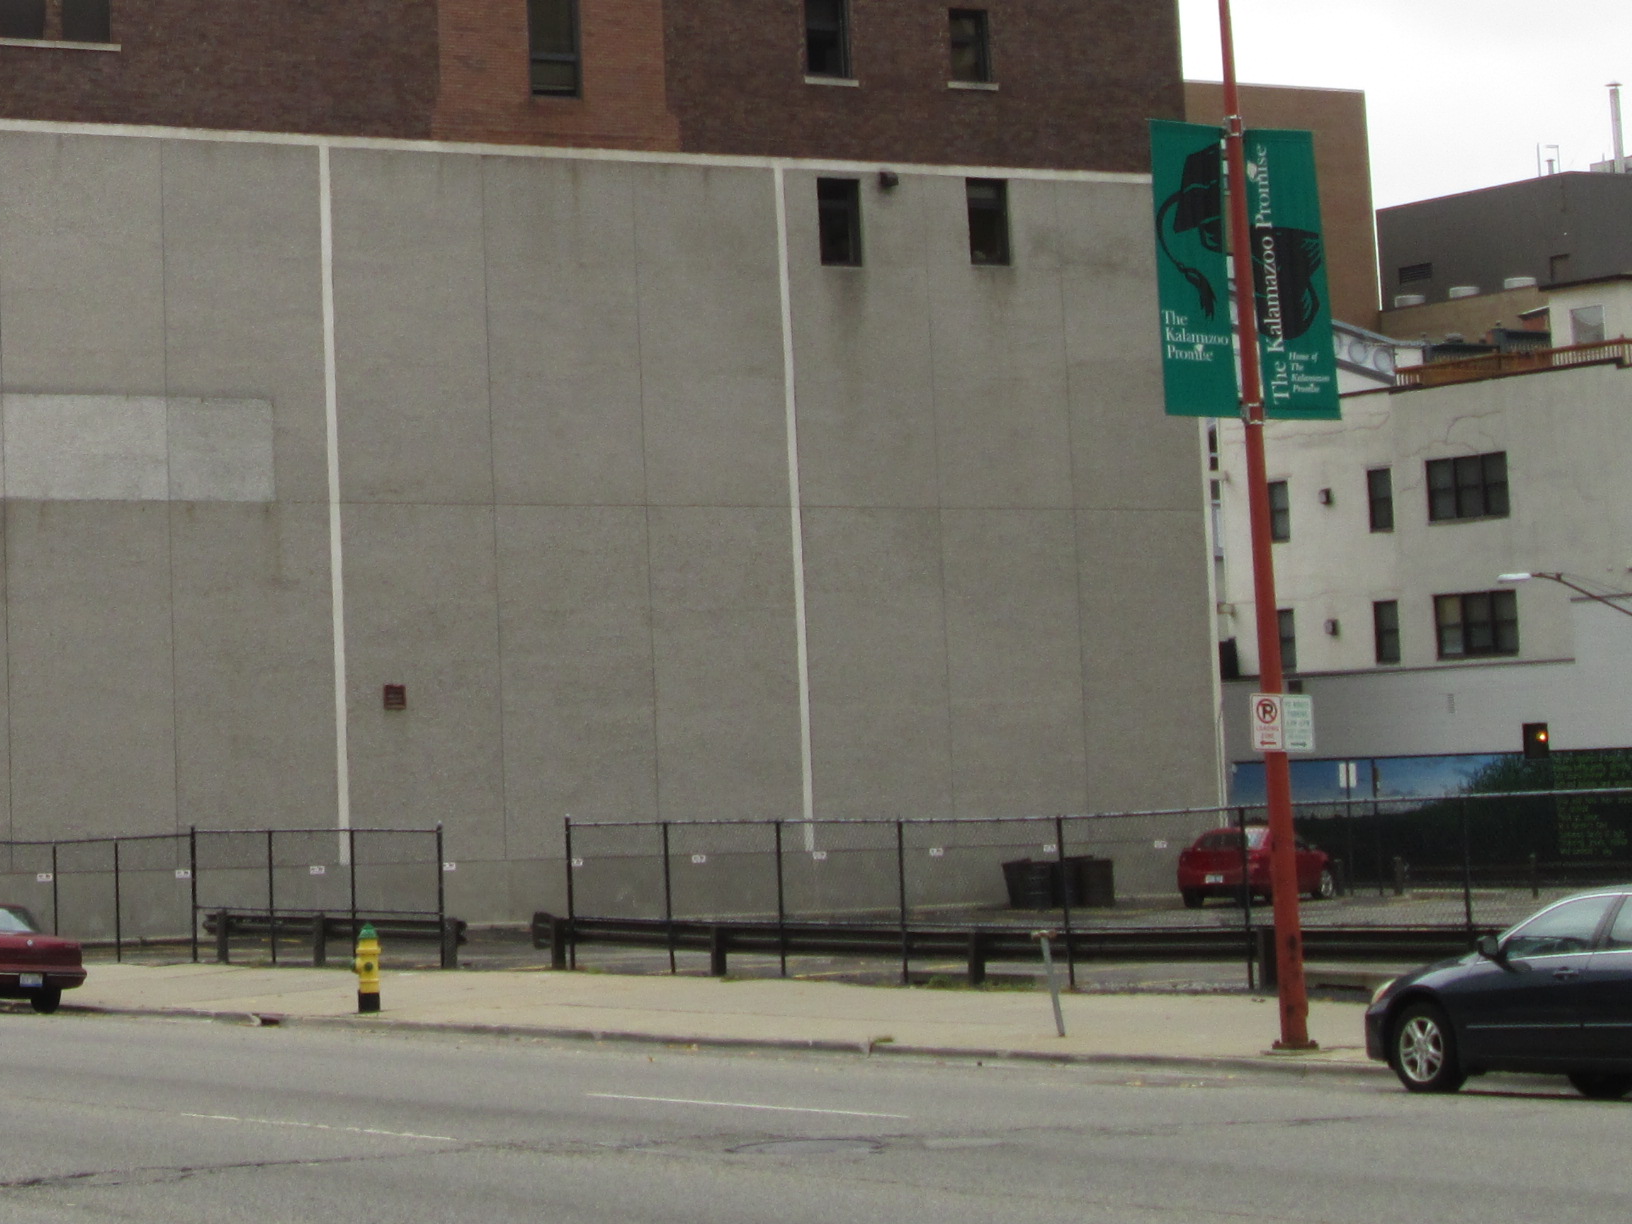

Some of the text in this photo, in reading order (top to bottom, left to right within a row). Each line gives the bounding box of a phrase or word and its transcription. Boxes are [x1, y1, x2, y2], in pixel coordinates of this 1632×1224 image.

[1162, 310, 1188, 326] The
[1254, 142, 1290, 406] The Kalamazoo Promise
